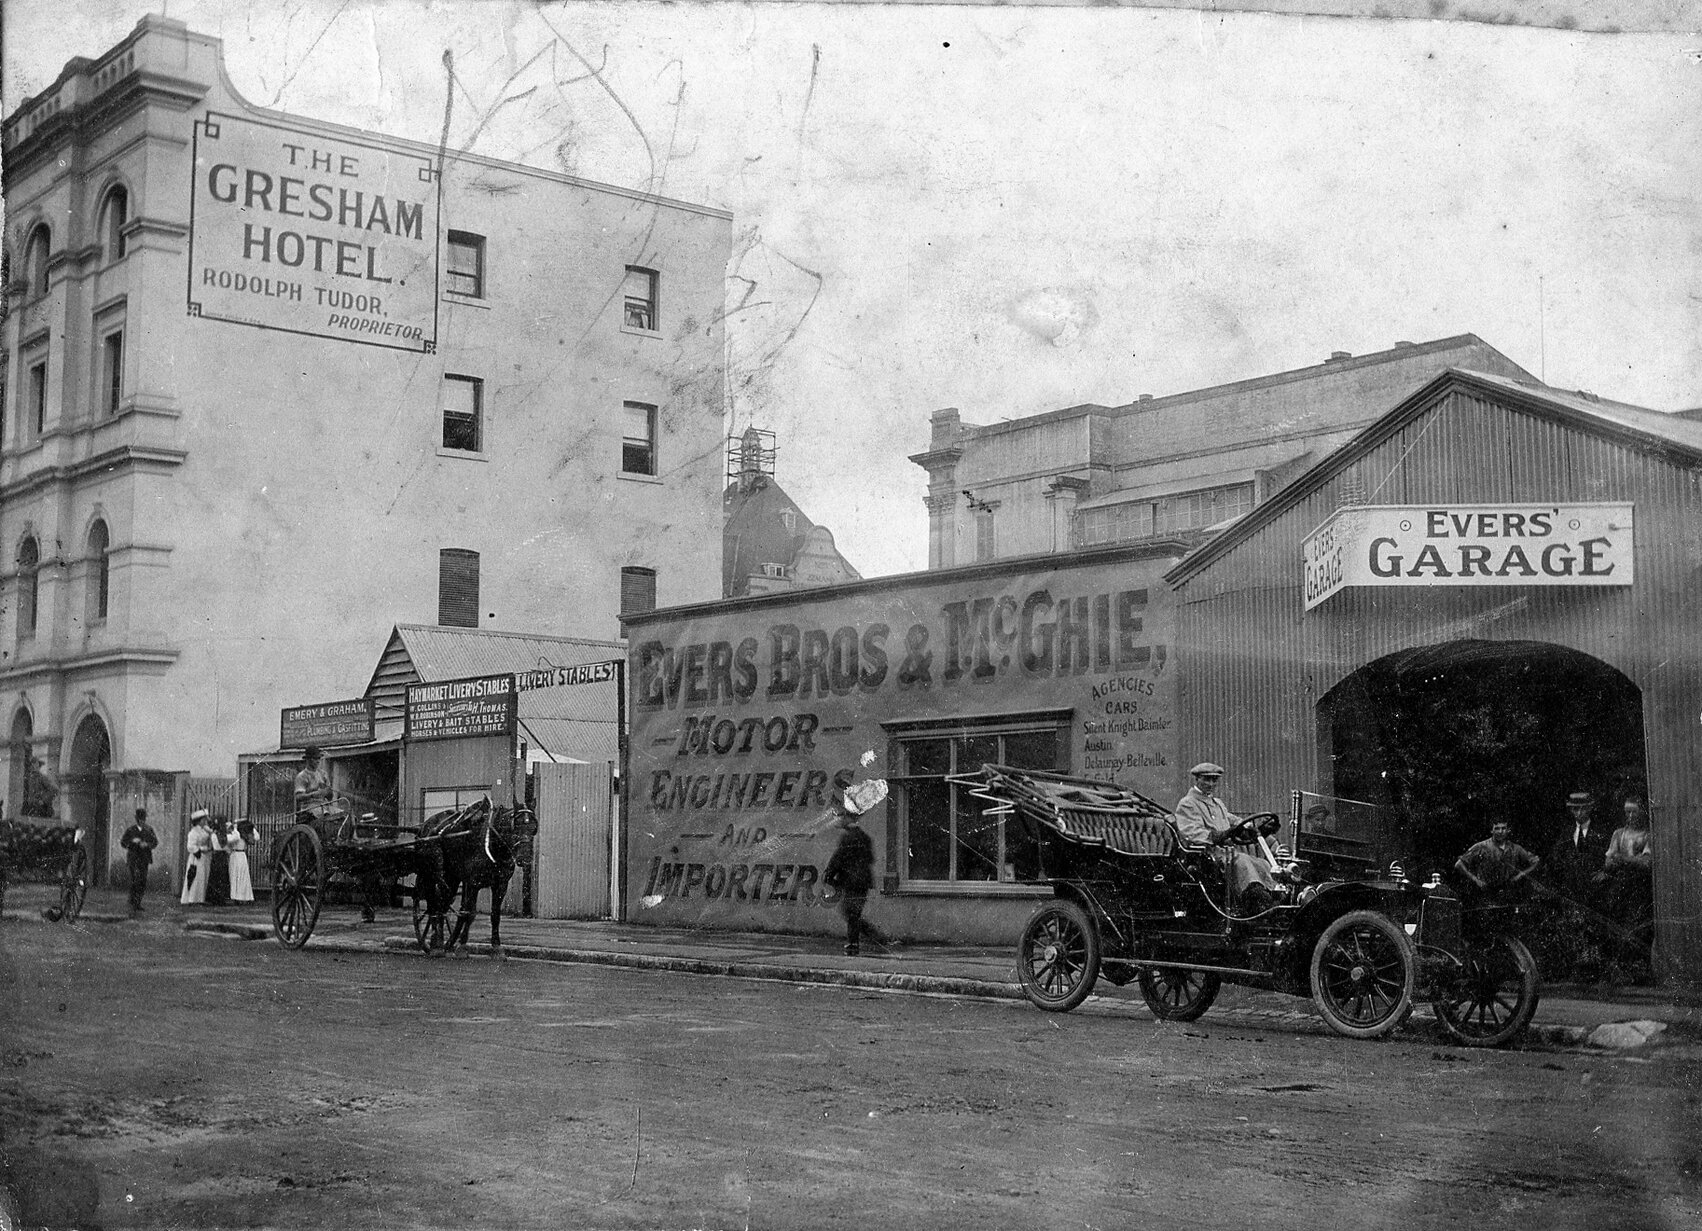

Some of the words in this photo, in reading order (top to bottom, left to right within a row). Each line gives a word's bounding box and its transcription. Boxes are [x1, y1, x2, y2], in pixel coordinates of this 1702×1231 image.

[282, 143, 359, 178] THE
[208, 163, 423, 240] GRESHAM
[243, 223, 406, 286] HOTEL.
[203, 268, 302, 301] RODOLPH
[314, 286, 388, 317] TUDOR,
[327, 313, 425, 342] PROPRIETOR.
[1426, 508, 1560, 538] EVERS'
[1368, 536, 1616, 578] GARAGE
[1307, 546, 1343, 602] GARAGE
[518, 669, 556, 692] LIVERY
[634, 637, 758, 712] EVERS
[766, 623, 891, 702] BROS
[897, 623, 933, 690] &
[408, 685, 448, 703] HAYMARKET
[449, 682, 476, 699] LIVERY
[476, 678, 510, 696] STABLES
[1092, 677, 1155, 701] AGENCIES
[289, 708, 318, 721] EMERY
[320, 708, 325, 718] &
[411, 719, 439, 730] LIVERY
[438, 720, 444, 728] &
[445, 717, 463, 727] BAIT
[465, 713, 506, 725] STABLES
[1105, 701, 1138, 714] CARS
[411, 729, 433, 738] HORSES
[469, 725, 482, 733] FOR
[674, 713, 820, 759] MOTOR
[1108, 718, 1137, 737] Knight
[1084, 739, 1113, 751] Austin
[648, 768, 855, 811] ENGINEERS
[719, 823, 768, 847] AND
